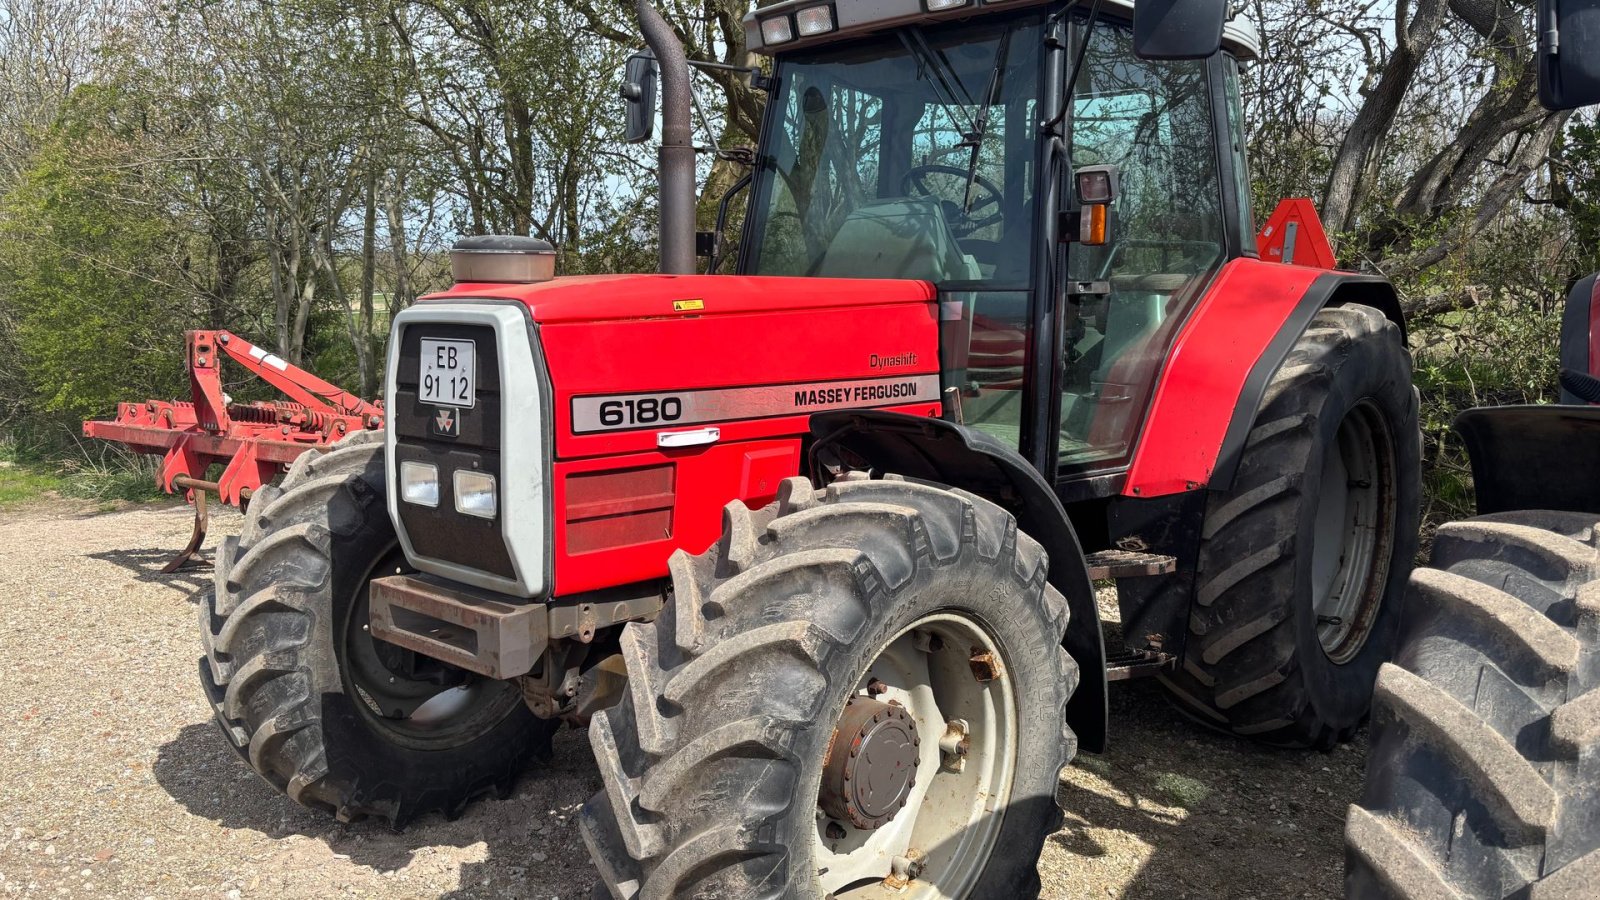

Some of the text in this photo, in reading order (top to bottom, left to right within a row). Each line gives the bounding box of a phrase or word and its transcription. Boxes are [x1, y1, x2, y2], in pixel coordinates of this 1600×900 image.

[437, 346, 458, 370] EB
[869, 352, 918, 370] Dynashift
[424, 374, 469, 400] 91 12
[794, 382, 917, 407] MASSEY FERGUSON
[599, 396, 682, 427] 6180
